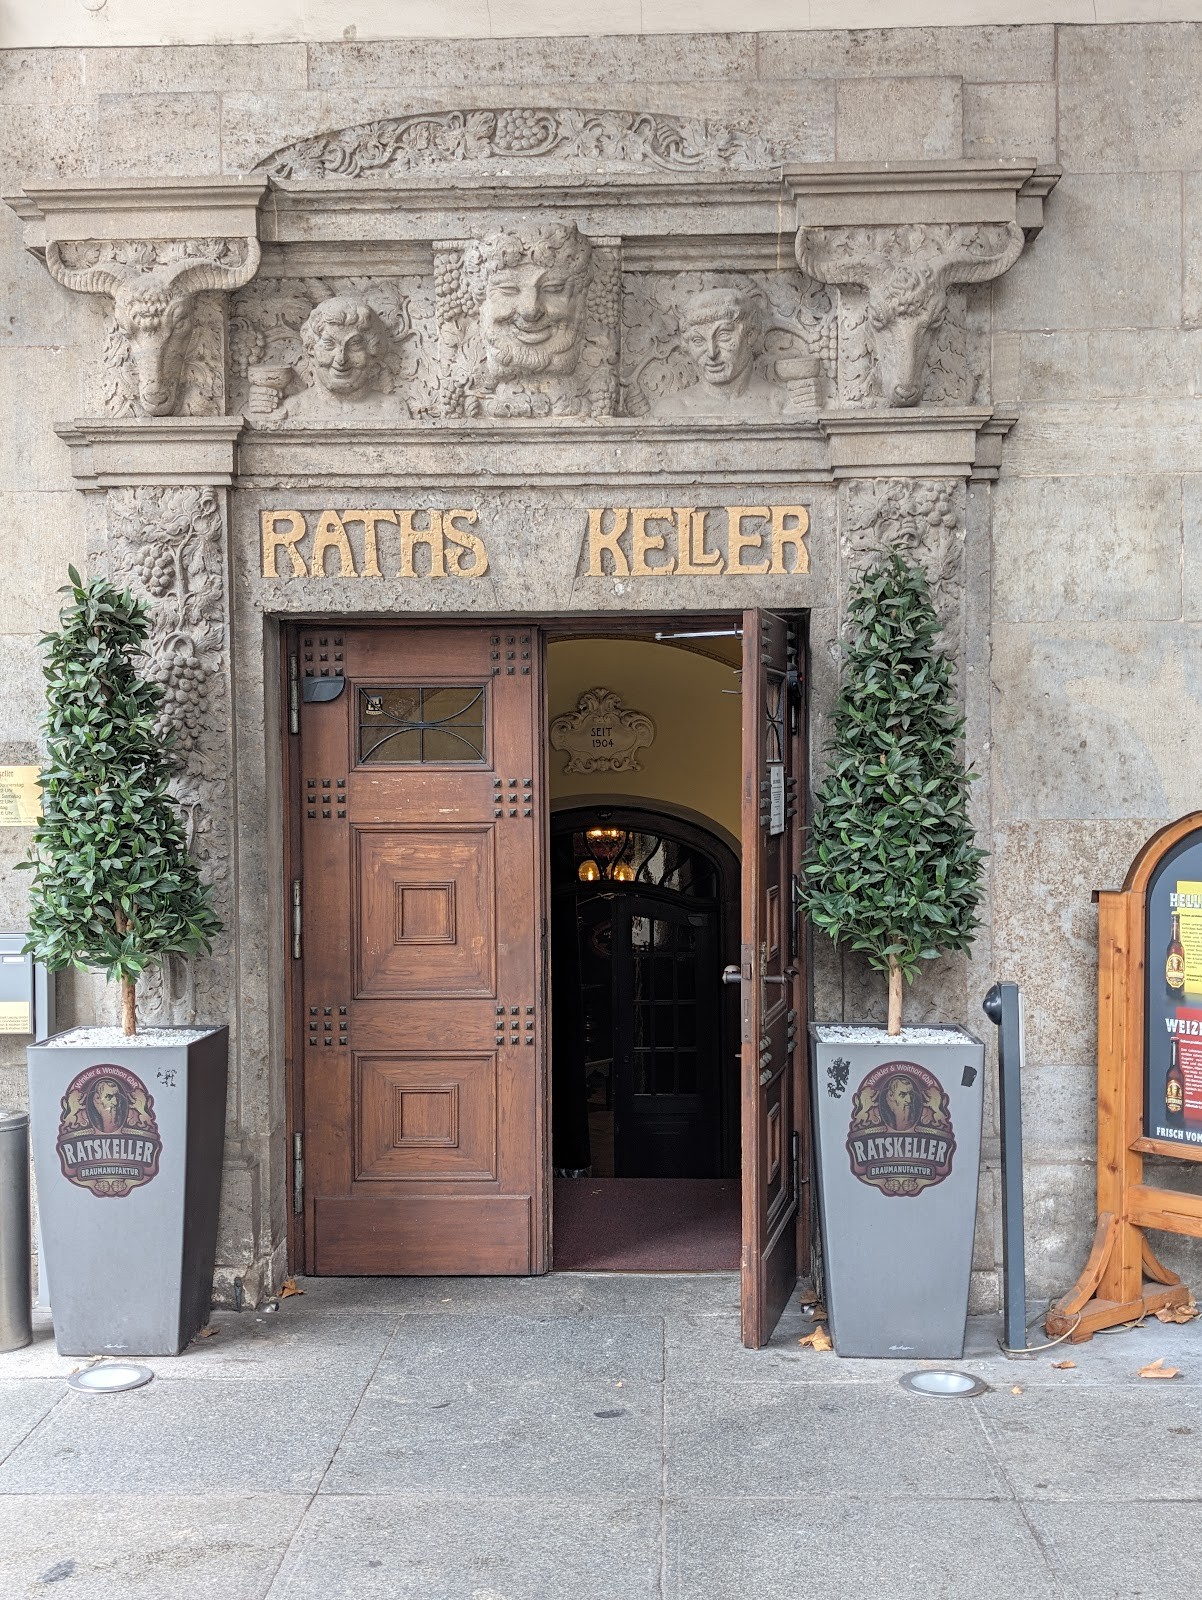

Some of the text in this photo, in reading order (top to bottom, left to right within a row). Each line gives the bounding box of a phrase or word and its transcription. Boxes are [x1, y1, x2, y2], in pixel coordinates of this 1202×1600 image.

[260, 505, 812, 579] RATHS KELLER
[590, 727, 613, 737] SEIT
[592, 738, 614, 748] 1904
[1169, 892, 1202, 909] HELL
[1156, 1126, 1184, 1140] FRISCH
[63, 1138, 154, 1165] RATSKELLER
[854, 1136, 947, 1163] RATSKELLER
[81, 1166, 139, 1177] BRAUMANUFAKTUR
[871, 1165, 931, 1176] BRAUMANUFAKTUR
